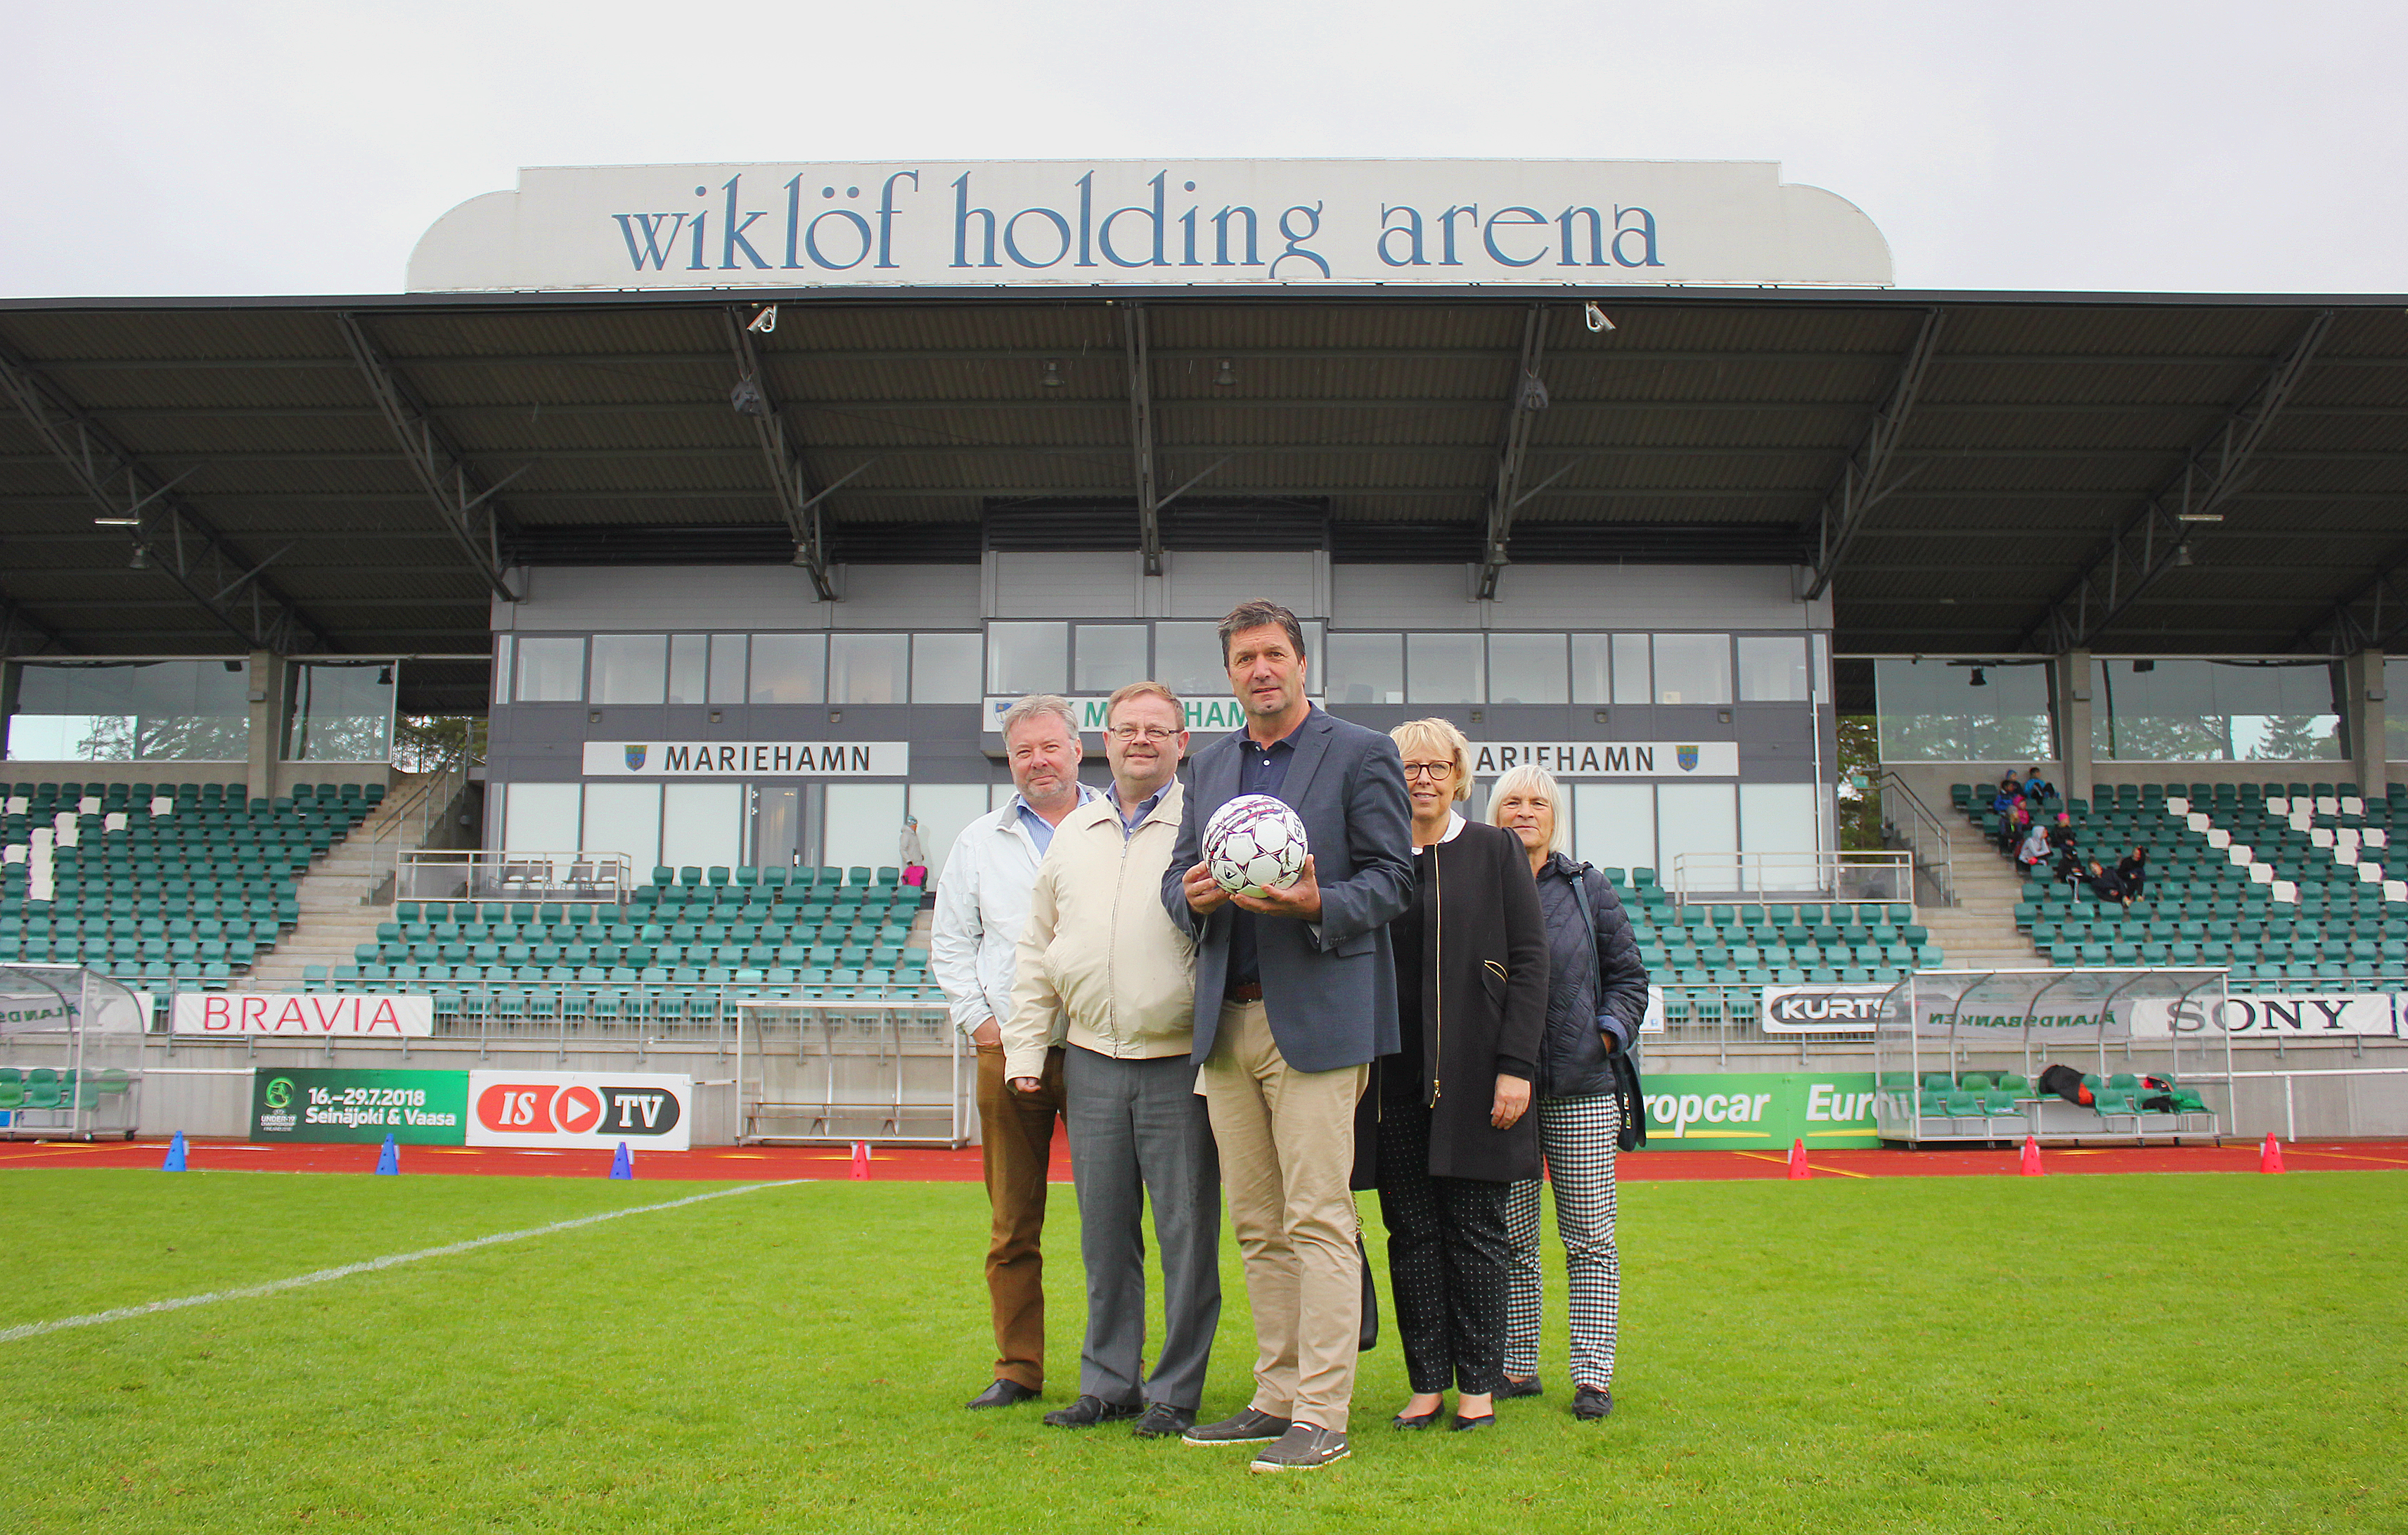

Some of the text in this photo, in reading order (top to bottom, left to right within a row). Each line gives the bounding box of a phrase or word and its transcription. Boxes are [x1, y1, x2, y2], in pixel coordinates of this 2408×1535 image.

[611, 169, 1666, 279] wiklöf holding arena
[663, 745, 871, 771] MARIEHAMN
[1476, 745, 1654, 772] ARIEHAMN
[202, 996, 402, 1033] BRAVIA
[1781, 998, 1898, 1020] KURTS
[2167, 998, 2354, 1033] SONY
[305, 1106, 456, 1129] Seinäjoki & Vaasa
[498, 1091, 664, 1129] IS TV
[1641, 1093, 1771, 1138] ropcar
